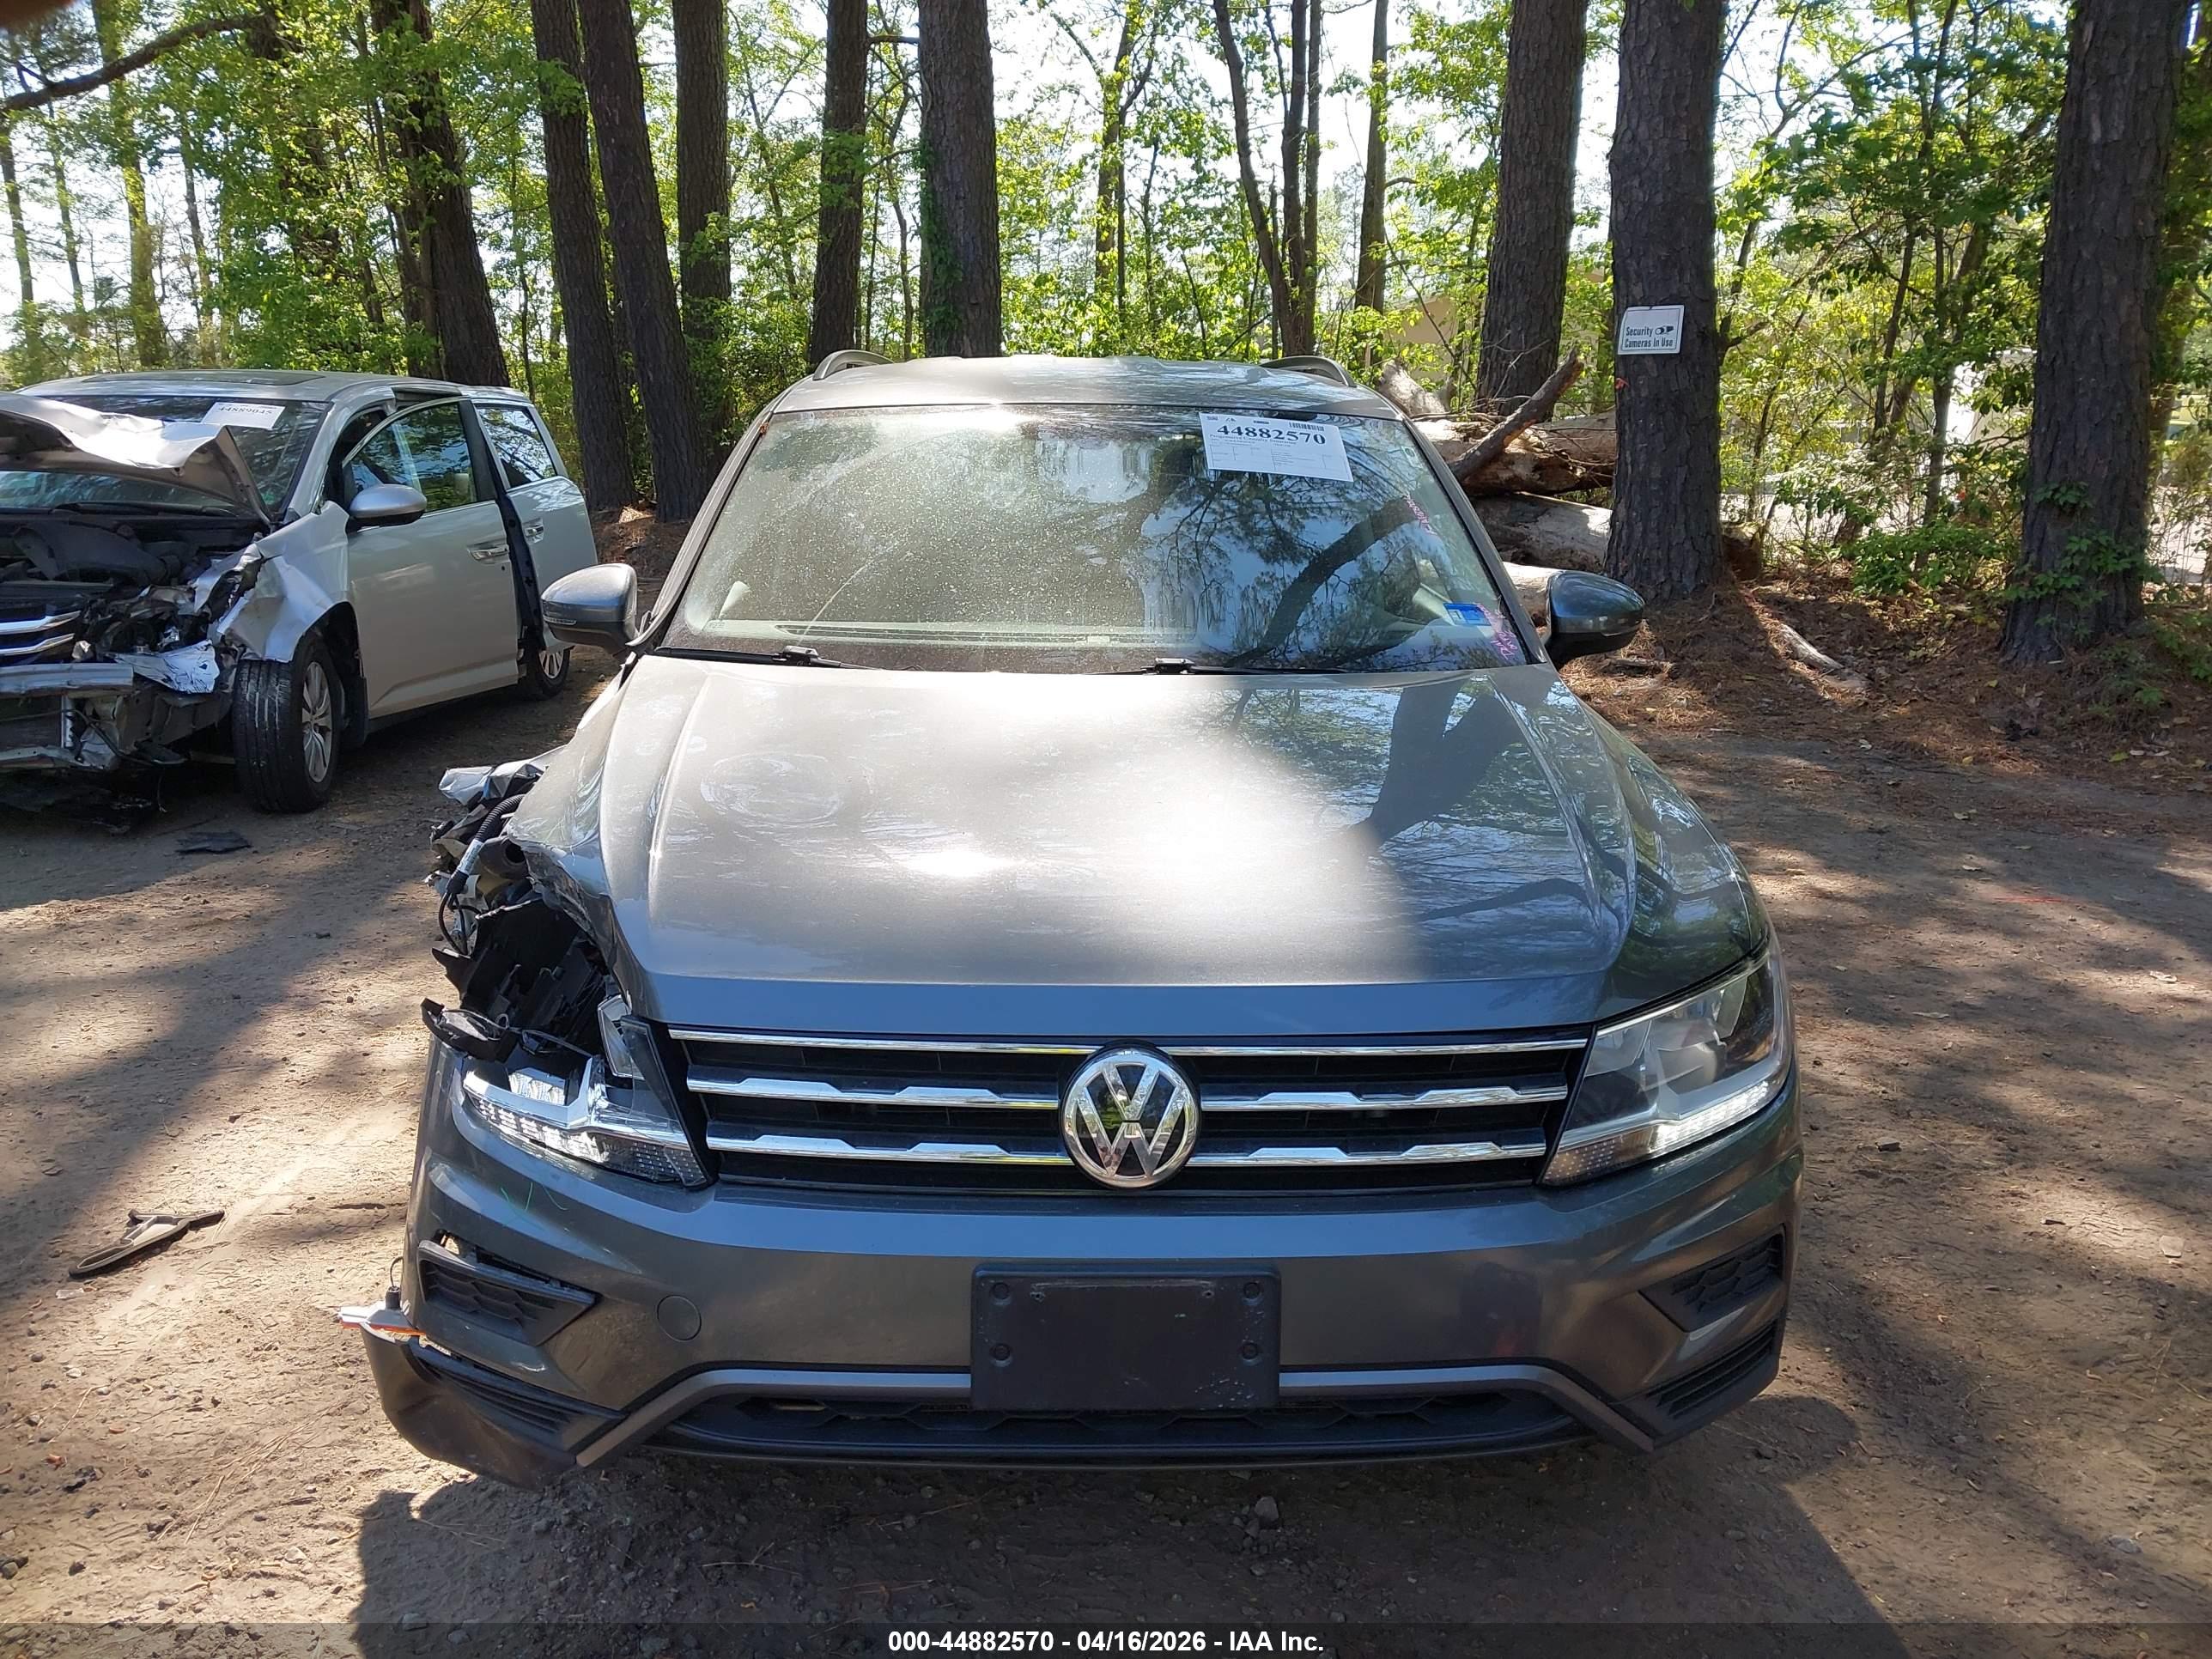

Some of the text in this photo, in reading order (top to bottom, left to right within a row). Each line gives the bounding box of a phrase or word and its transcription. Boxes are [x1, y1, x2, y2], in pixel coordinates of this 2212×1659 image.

[1626, 326, 1653, 337] Security
[1625, 337, 1674, 348] Cameras In Use
[1217, 425, 1326, 445] 44882570
